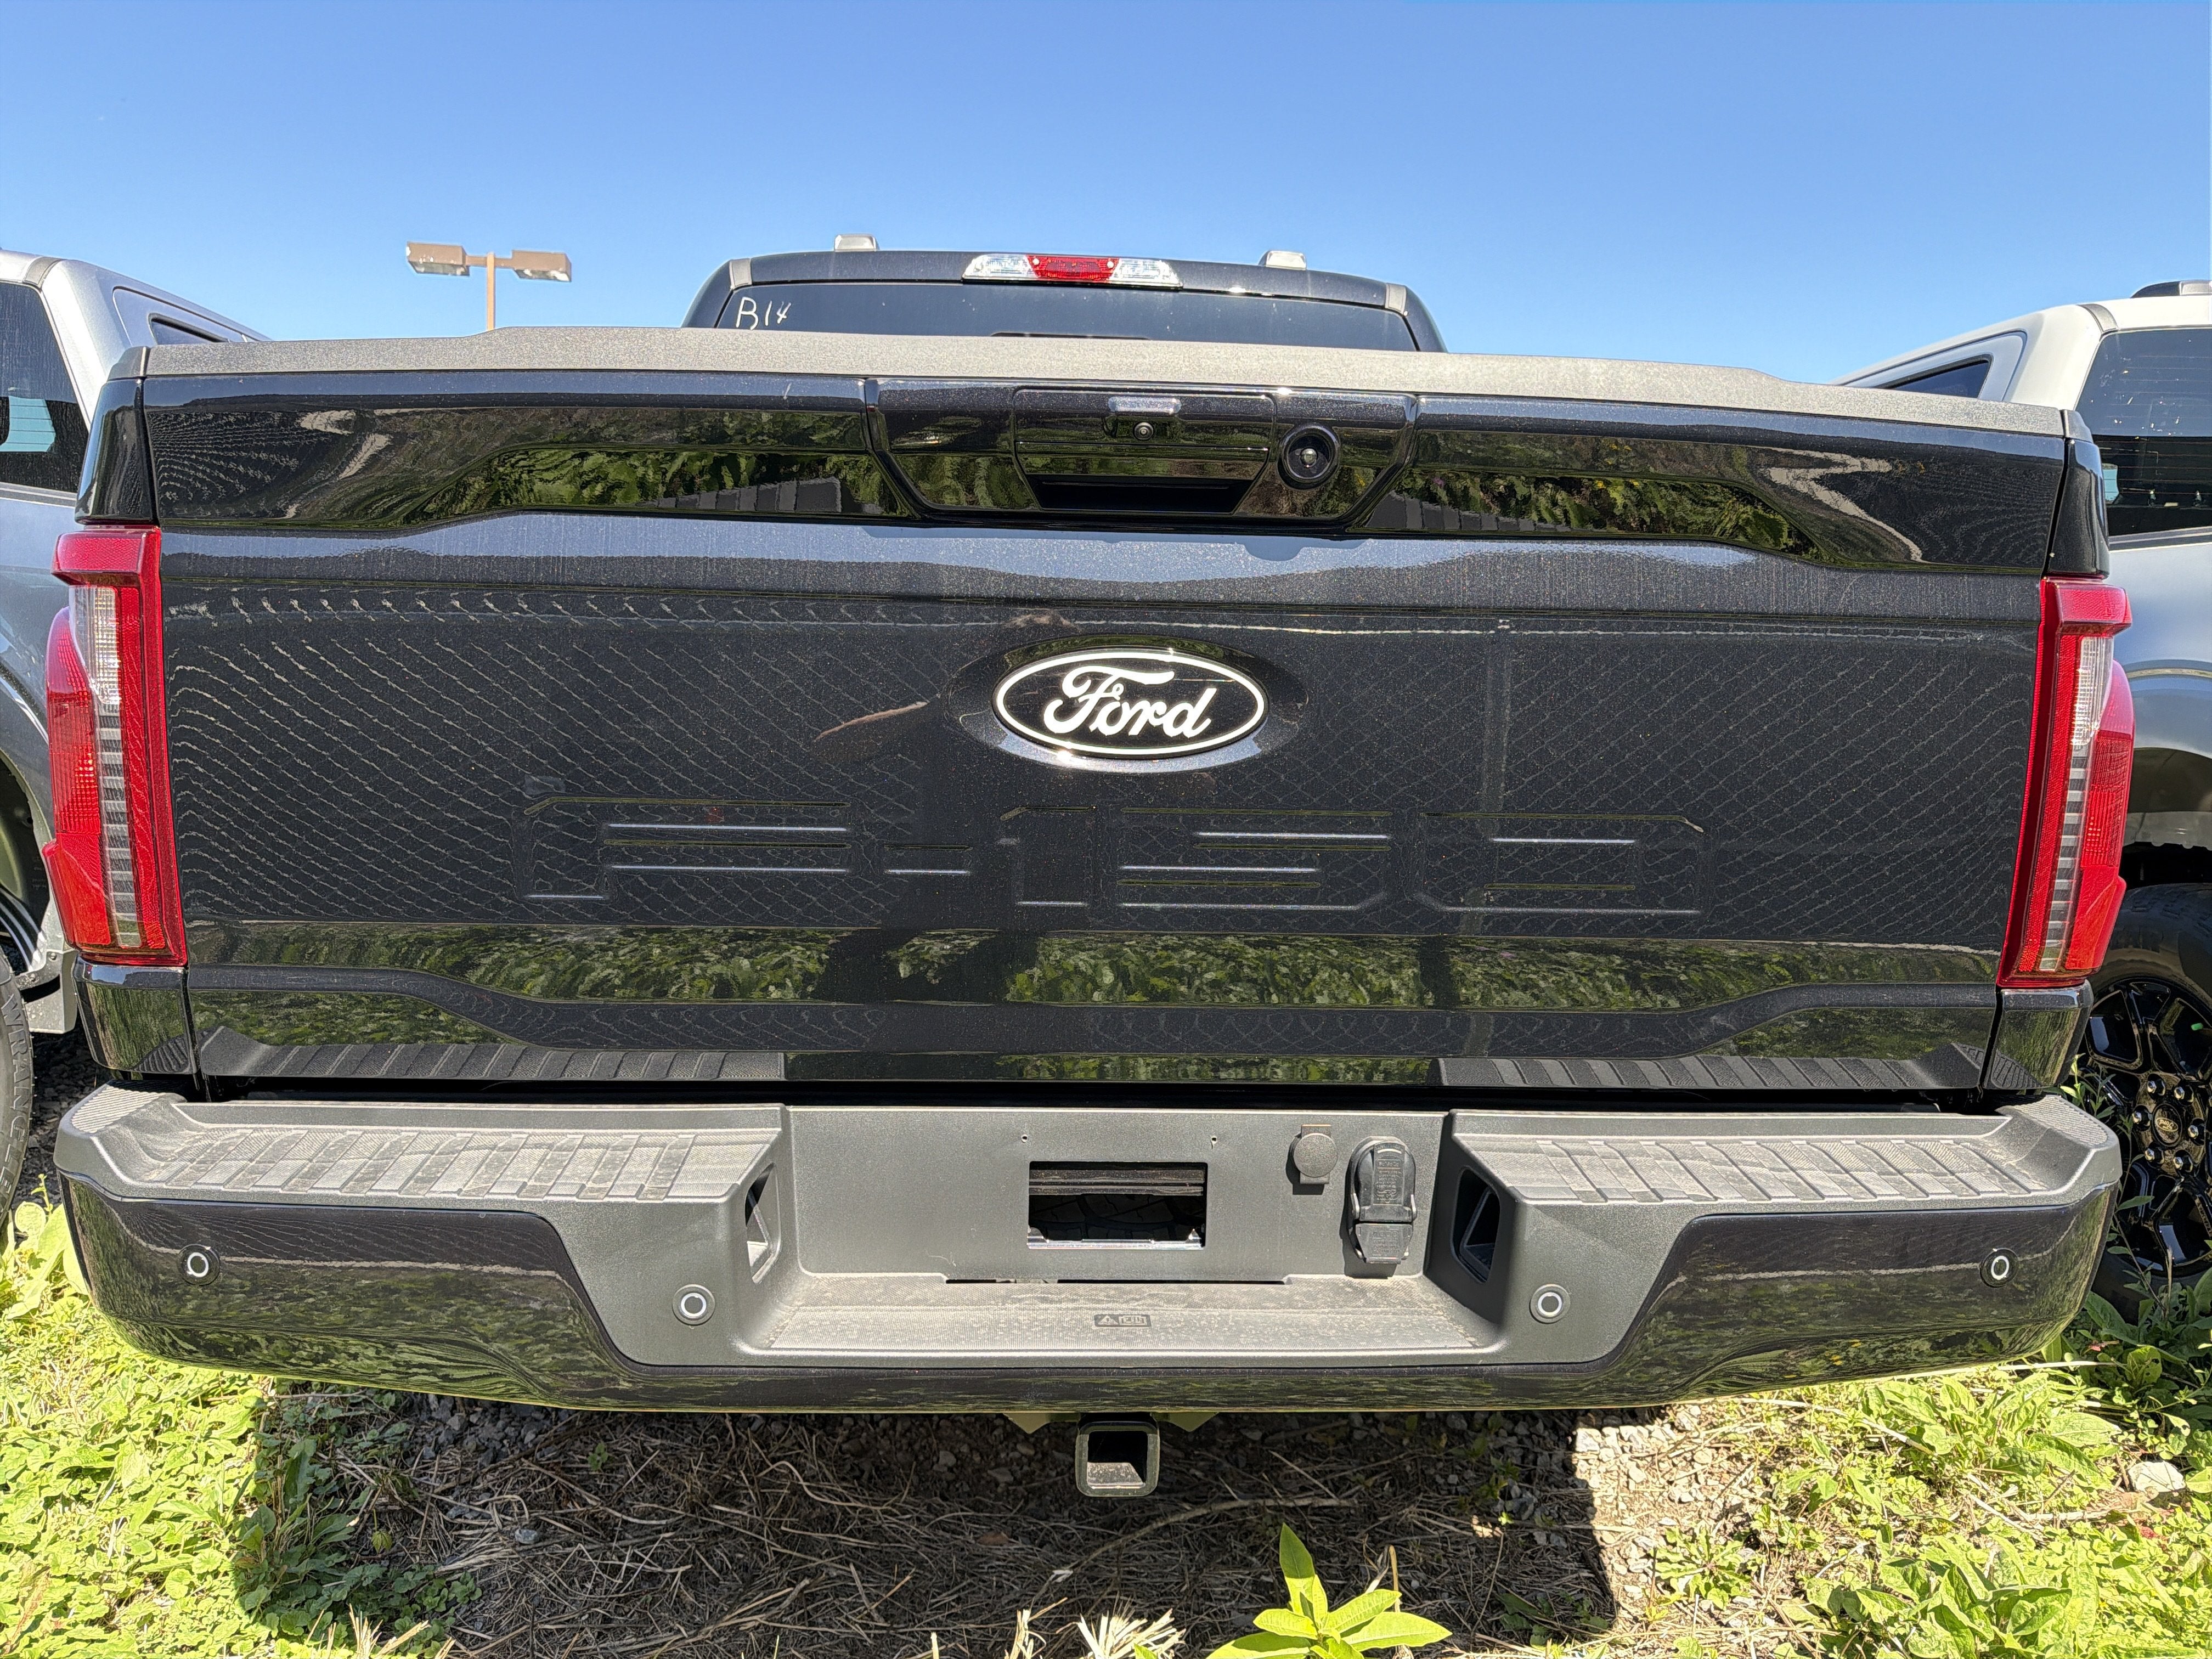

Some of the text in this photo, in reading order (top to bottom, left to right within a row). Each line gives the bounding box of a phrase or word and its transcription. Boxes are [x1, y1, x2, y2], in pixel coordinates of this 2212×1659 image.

[736, 296, 792, 330] B14
[1043, 665, 1217, 738] Ford
[515, 795, 1707, 915] F-150
